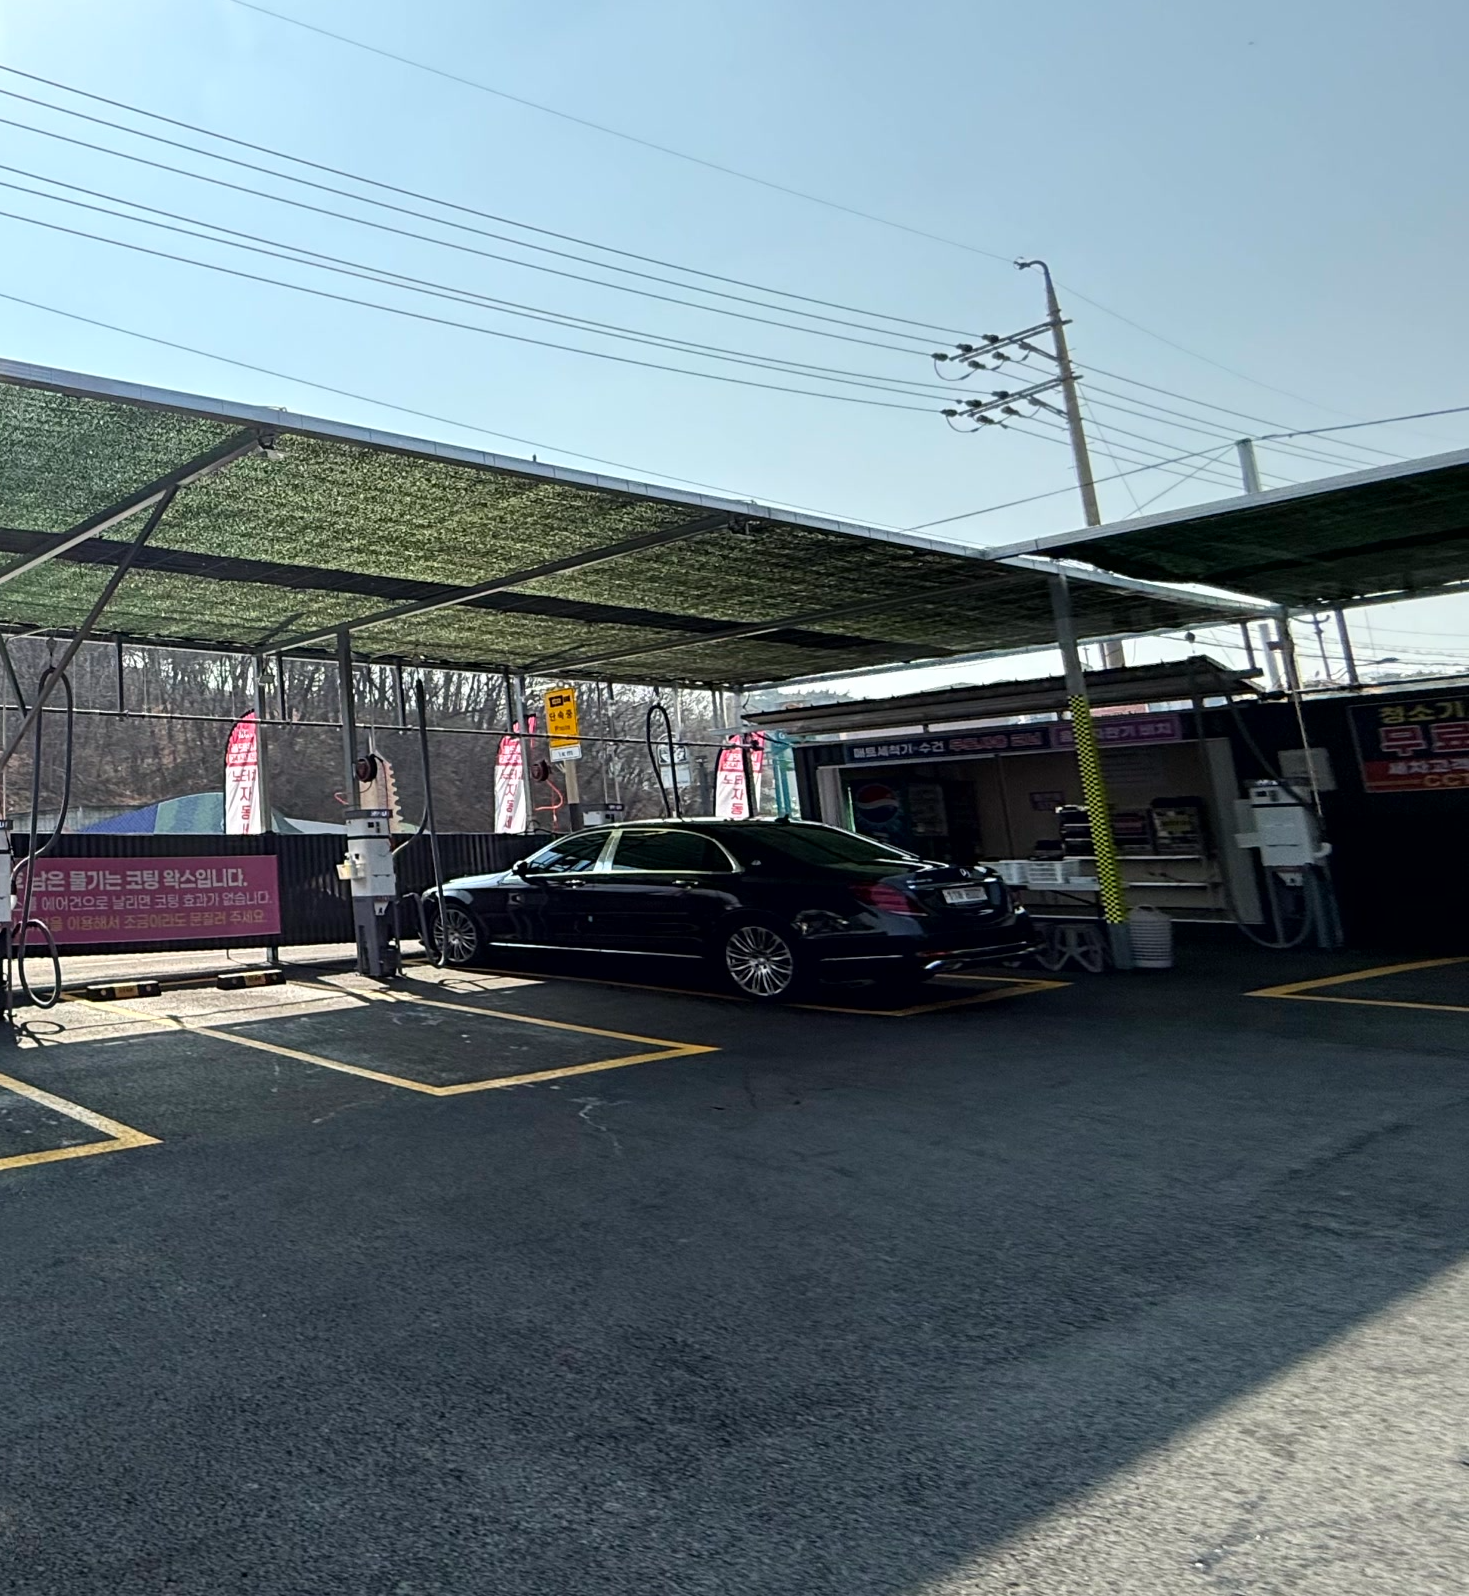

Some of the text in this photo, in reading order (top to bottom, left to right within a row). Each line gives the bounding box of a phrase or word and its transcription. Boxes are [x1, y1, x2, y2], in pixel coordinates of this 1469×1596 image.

[1378, 700, 1464, 724] 청소기
[1378, 721, 1469, 757] 무료
[70, 870, 122, 891] 물기는
[125, 869, 160, 890] 코팅
[163, 868, 248, 890] 왁스입니다.
[41, 896, 109, 911] 에어건으로
[112, 894, 151, 910] 날리면
[154, 893, 179, 909] 코팅
[182, 892, 220, 908] 효과가
[222, 890, 273, 906] 없습니다.
[68, 915, 120, 931] 이용해서
[123, 913, 187, 929] 조금이라도
[190, 911, 227, 927] 문질러
